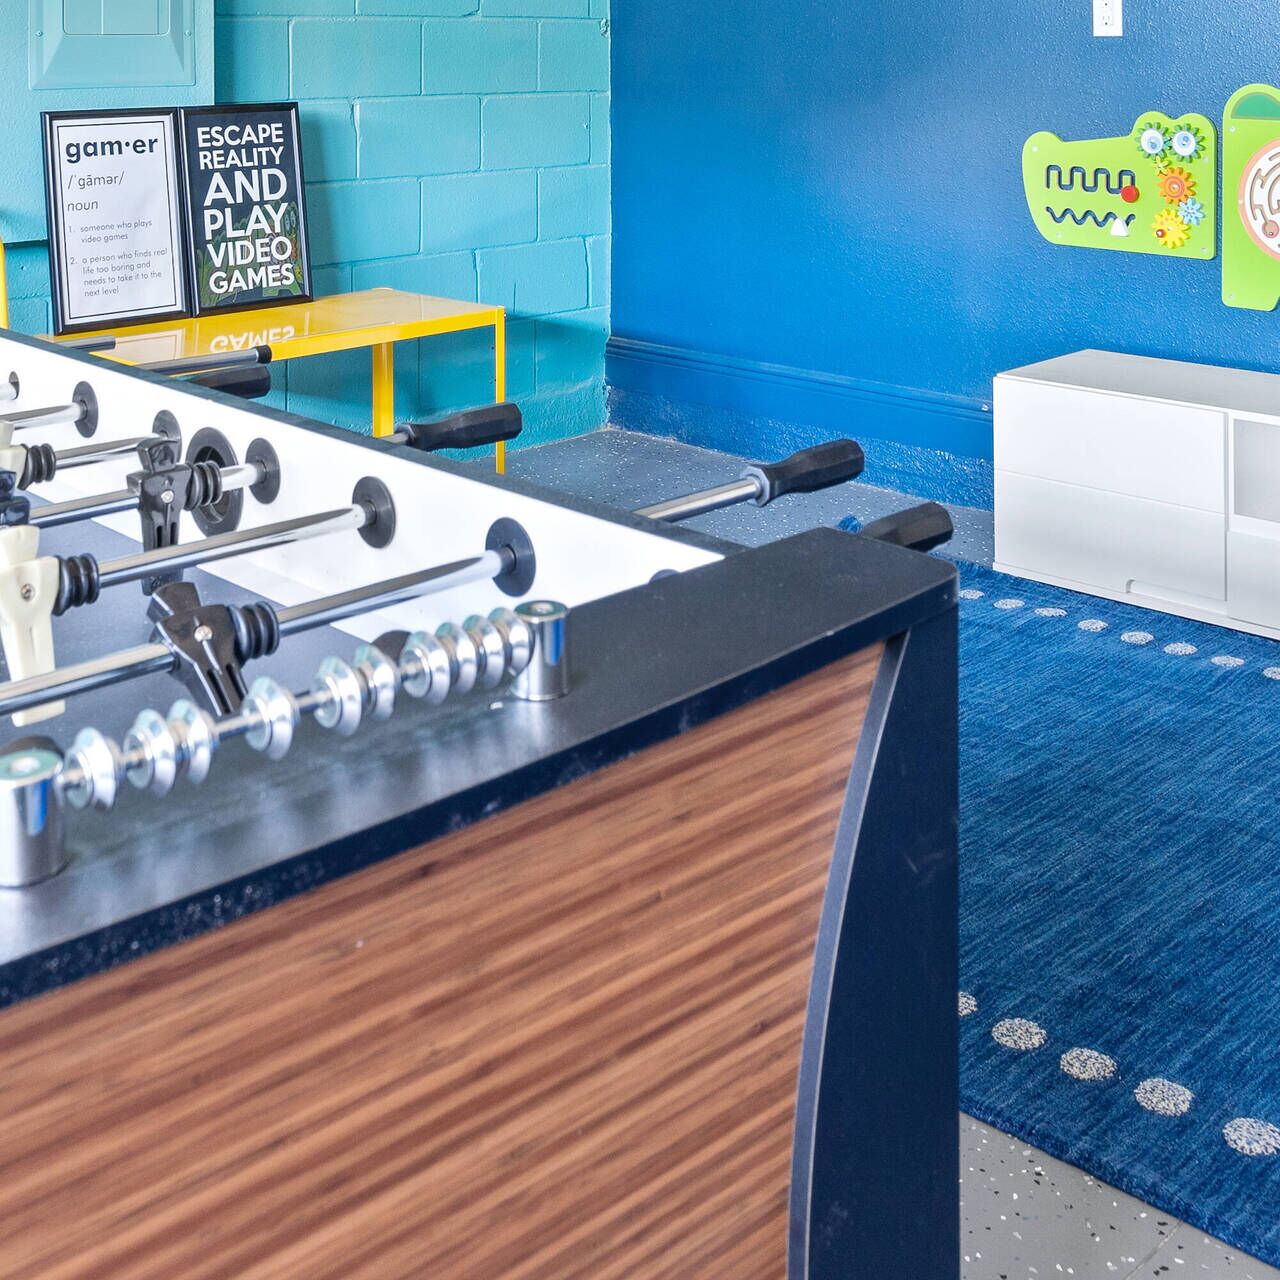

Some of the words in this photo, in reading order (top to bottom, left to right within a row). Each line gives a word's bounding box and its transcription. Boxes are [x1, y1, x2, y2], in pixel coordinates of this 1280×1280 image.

[197, 123, 284, 148] ESCAPE
[199, 146, 284, 170] REALITY
[203, 168, 287, 207] AND
[67, 201, 99, 212] noun
[80, 223, 115, 232] someone
[117, 221, 132, 229] who
[134, 220, 152, 229] plays
[203, 202, 289, 240] PLAY
[81, 235, 101, 243] video
[104, 233, 128, 243] games
[90, 255, 115, 264] person
[118, 252, 133, 260] who
[134, 250, 152, 258] finds
[206, 236, 292, 268] VIDEO
[82, 266, 94, 274] life
[111, 263, 134, 272] boring
[136, 260, 151, 268] and
[84, 277, 106, 286] needs
[118, 274, 133, 282] take
[209, 263, 295, 294] GAMES
[84, 289, 100, 297] next
[102, 286, 119, 295] level
